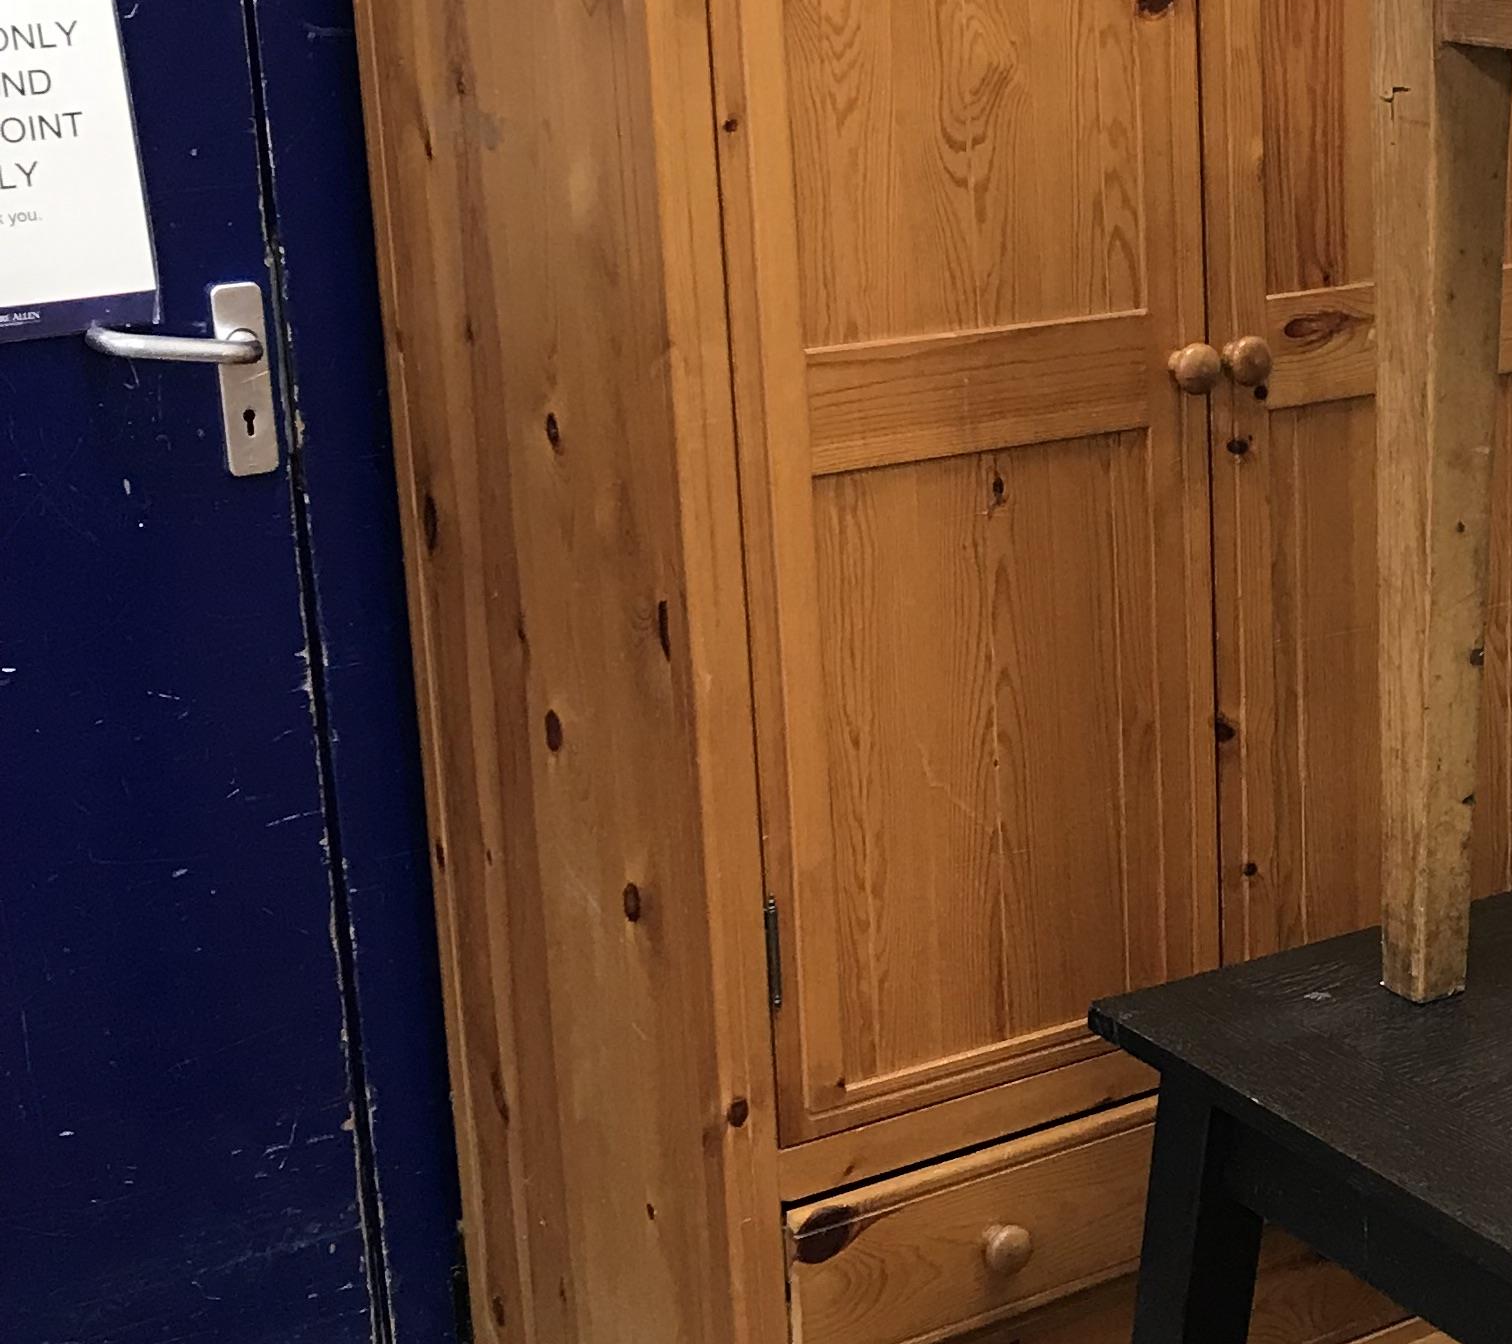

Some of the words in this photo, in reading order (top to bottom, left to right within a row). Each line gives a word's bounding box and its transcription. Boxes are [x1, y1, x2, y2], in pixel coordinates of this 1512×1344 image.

[0, 112, 82, 143] OINT
[0, 161, 37, 189] LY
[8, 211, 43, 227] you.
